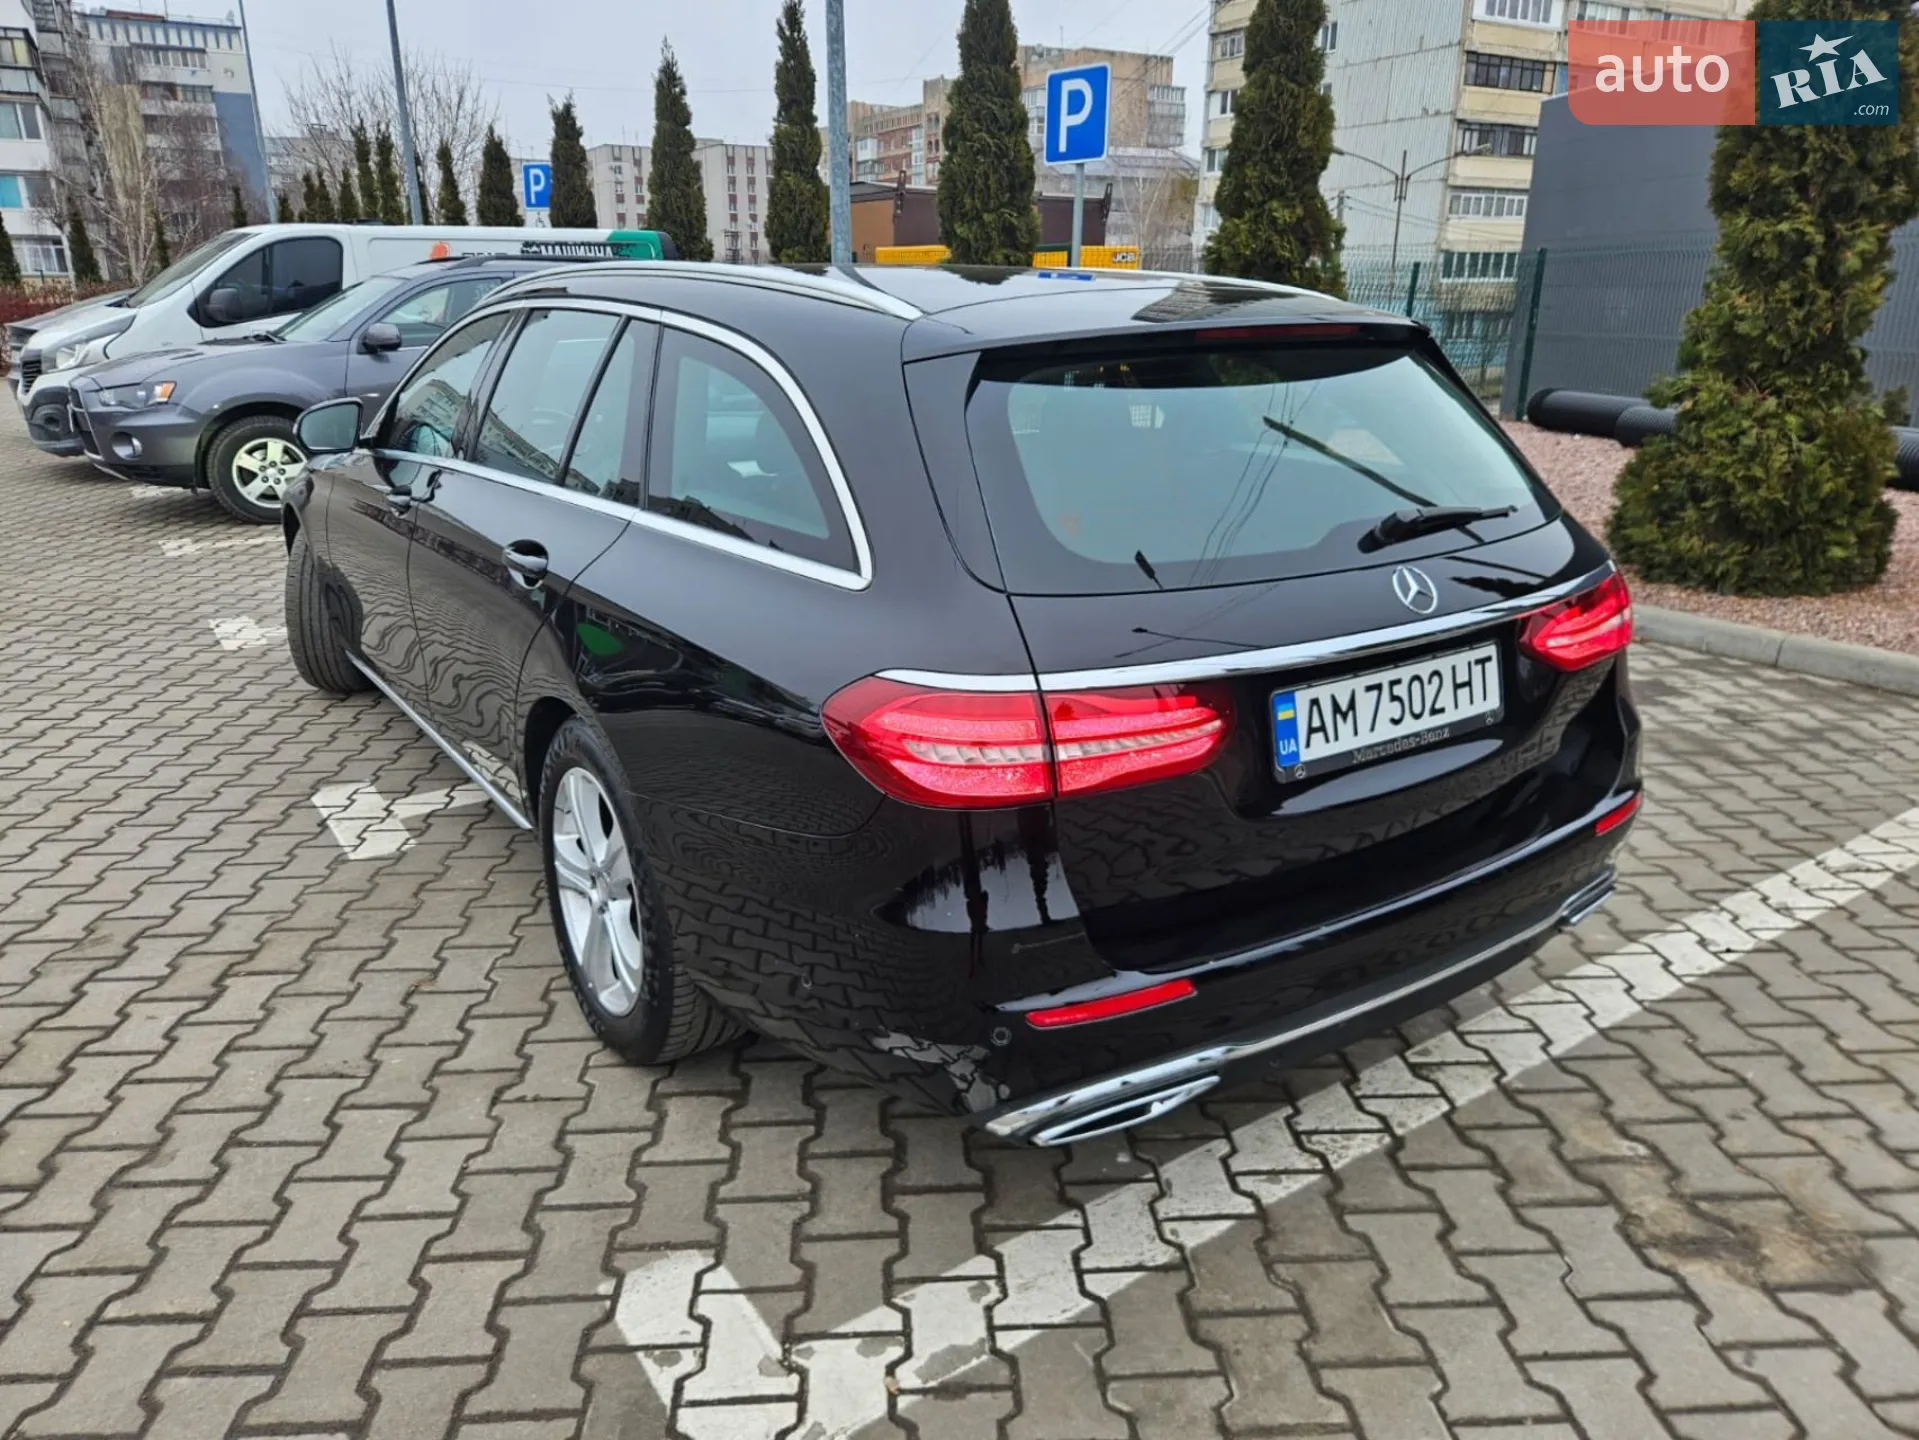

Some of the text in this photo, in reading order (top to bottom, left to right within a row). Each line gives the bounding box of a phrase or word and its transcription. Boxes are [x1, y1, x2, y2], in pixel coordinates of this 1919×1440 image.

[1058, 78, 1093, 153] P
[529, 168, 546, 205] P
[1279, 739, 1298, 755] UA
[1352, 727, 1450, 764] Mercedes-Benz
